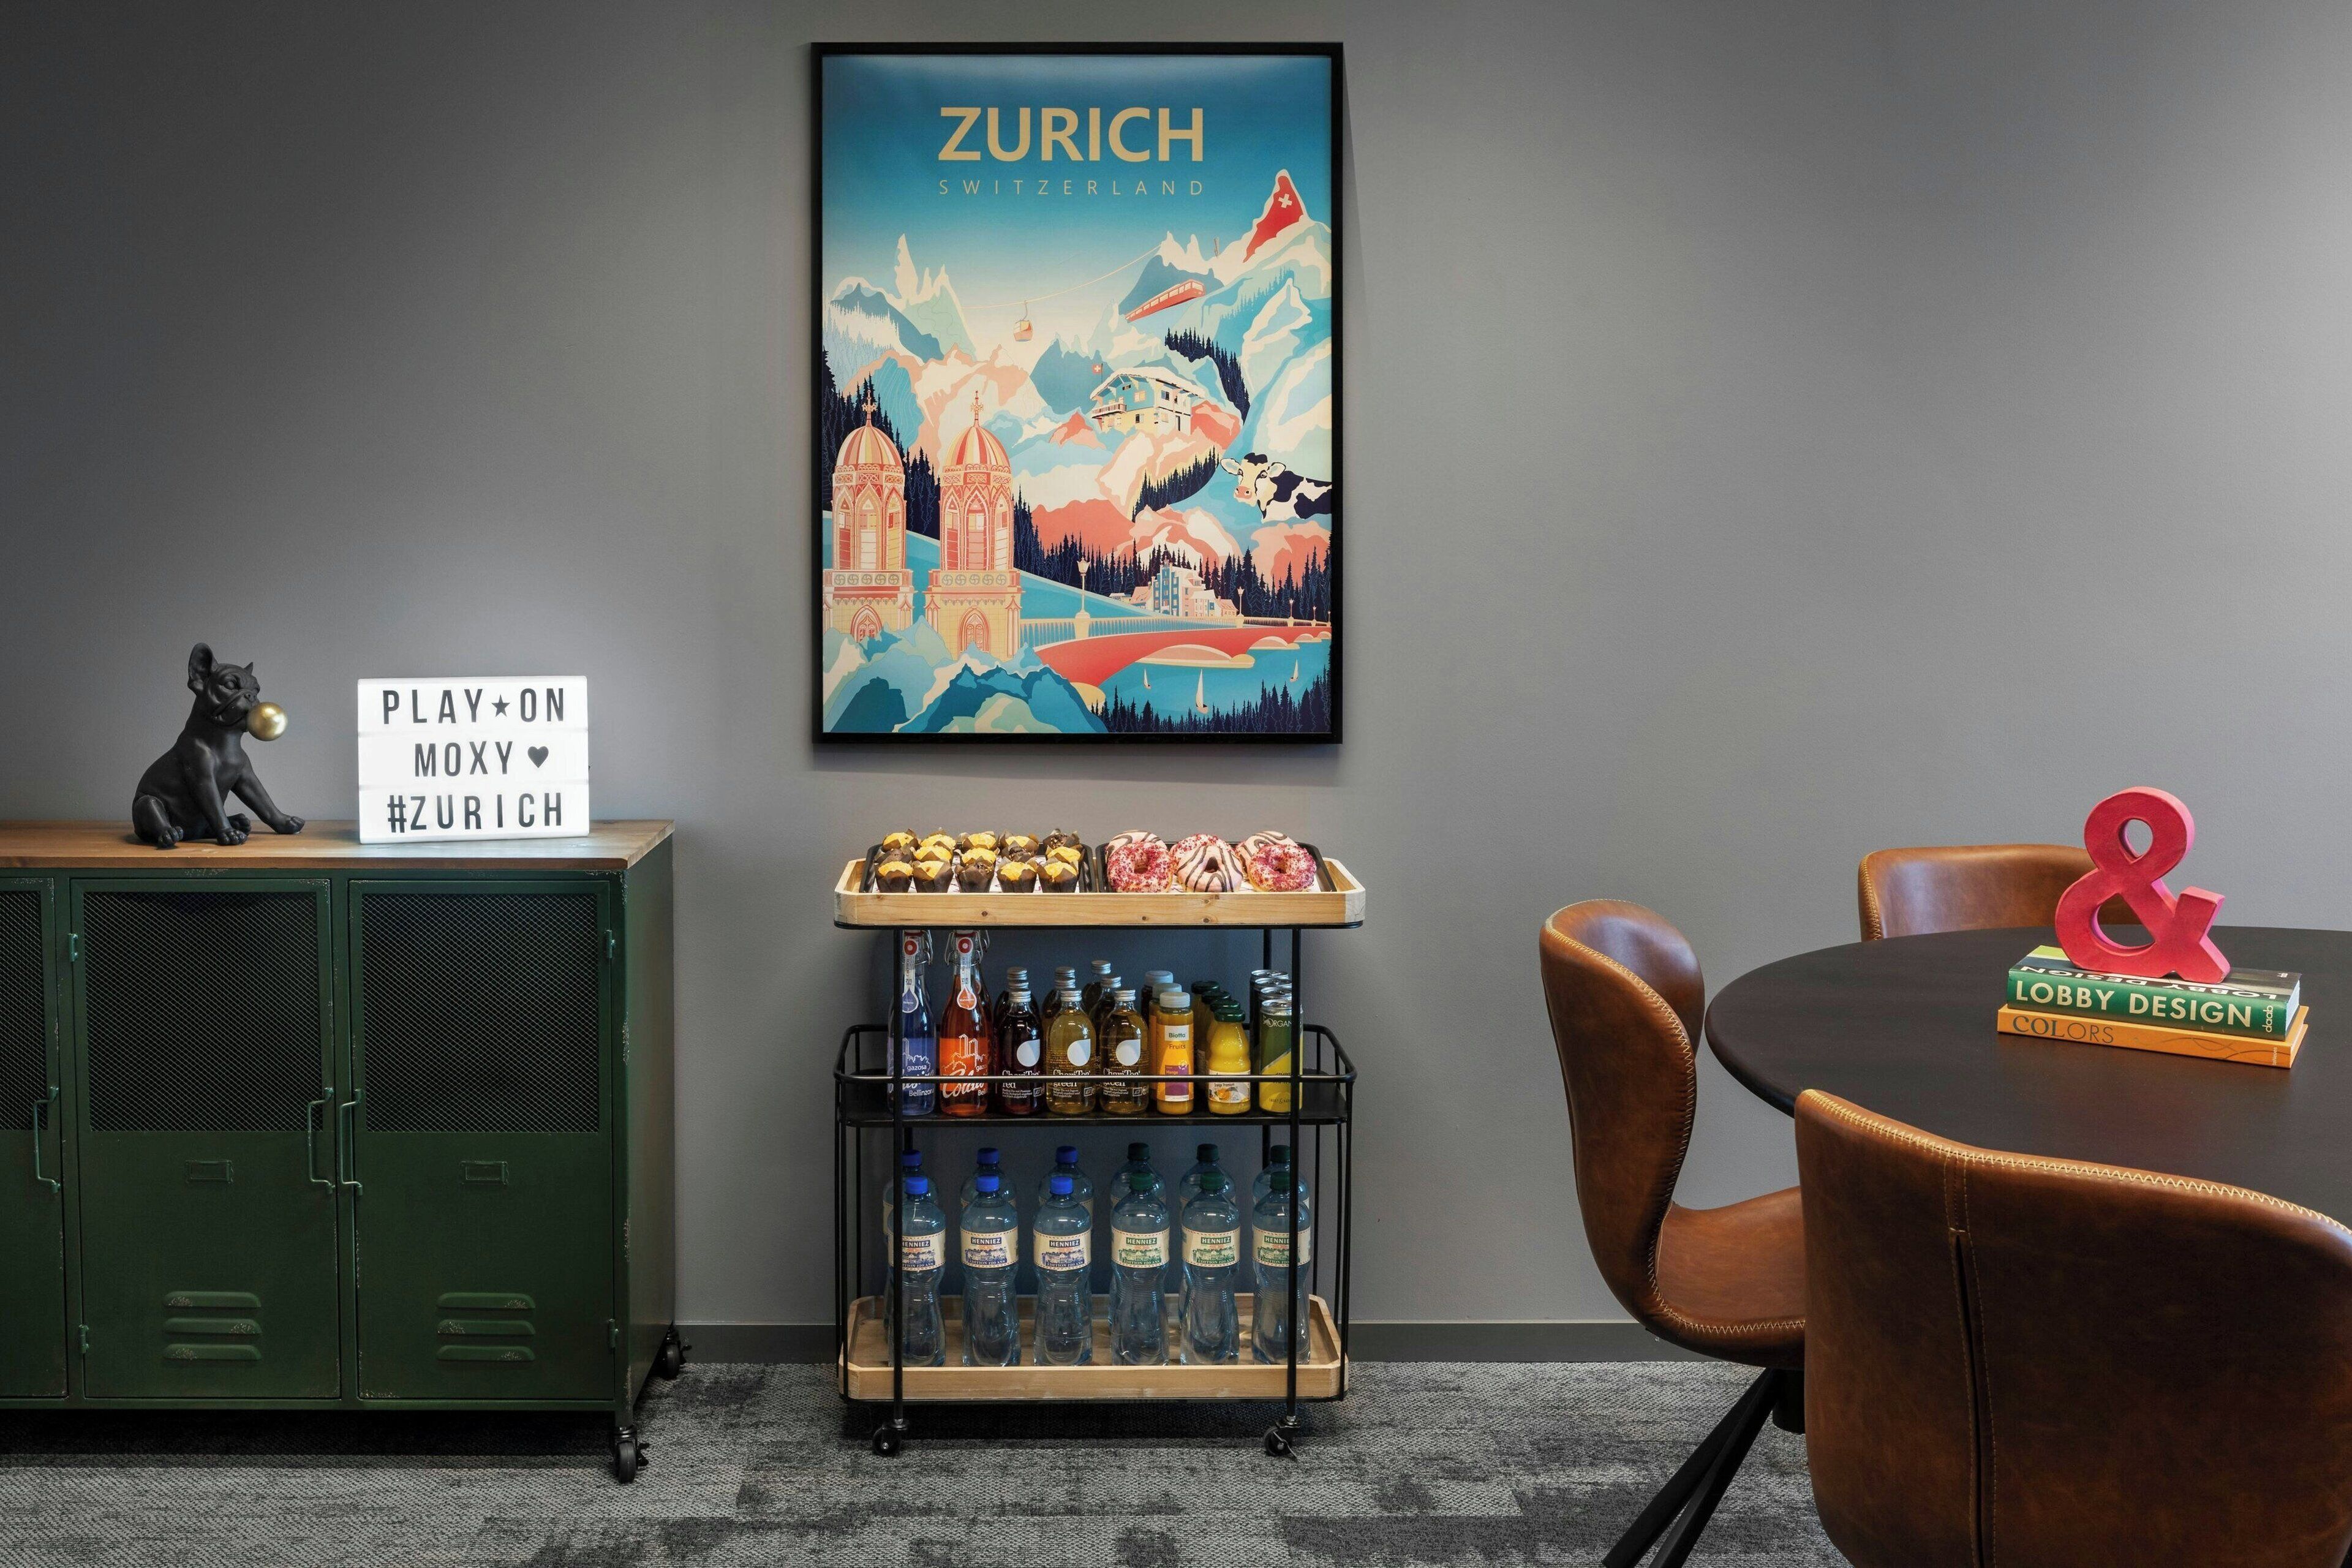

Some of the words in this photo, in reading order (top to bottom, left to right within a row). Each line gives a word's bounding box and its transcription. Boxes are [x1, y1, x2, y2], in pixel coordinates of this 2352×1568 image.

[938, 107, 1203, 162] ZURICH
[939, 180, 1203, 195] SWITZERLAND
[382, 688, 483, 725] PLAY
[519, 688, 564, 722] ON
[415, 741, 513, 777] MOXY
[387, 793, 562, 833] #ZURICH
[2020, 966, 2147, 986] DESIGN
[2016, 980, 2115, 1011] LOBBY
[2129, 993, 2252, 1028] DESIGN
[2162, 983, 2277, 1000] LOBBY
[1268, 1019, 1292, 1027] ORGAN
[2013, 1015, 2114, 1044] COLORS
[2262, 1005, 2274, 1033] daab
